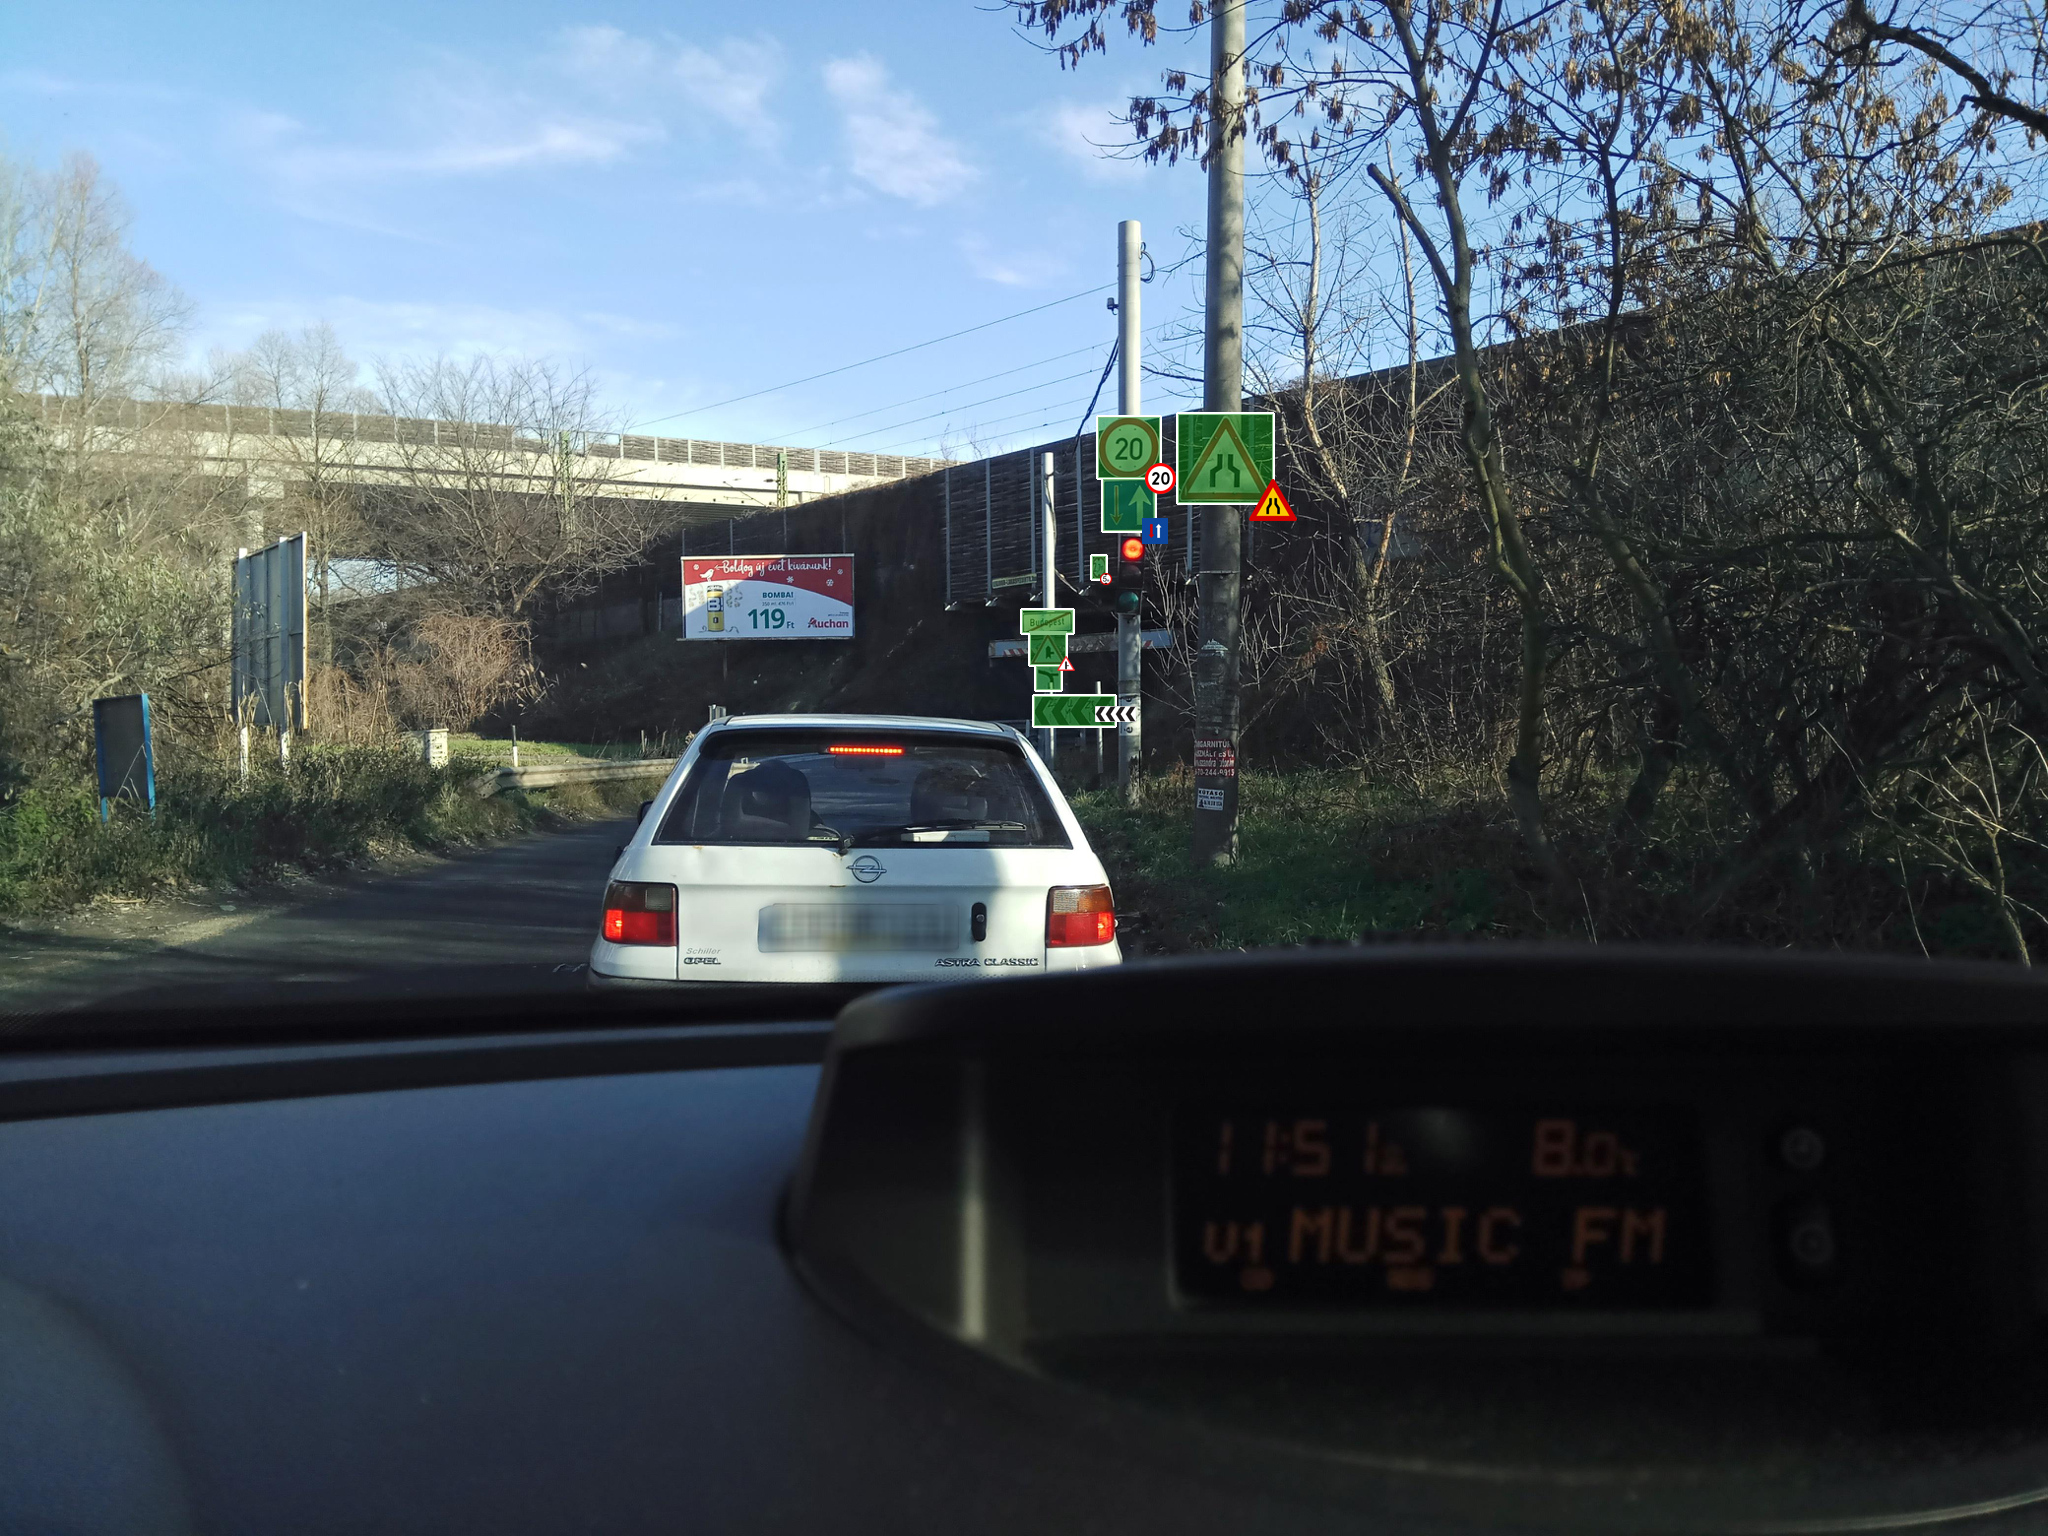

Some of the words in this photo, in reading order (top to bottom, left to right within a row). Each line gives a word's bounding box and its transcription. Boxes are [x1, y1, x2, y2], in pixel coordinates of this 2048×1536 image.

[1115, 437, 1143, 460] 20
[722, 560, 753, 577] Boldog
[756, 561, 765, 577] új
[768, 560, 785, 572] évet
[747, 608, 785, 629] 119
[786, 621, 795, 629] Ft
[807, 617, 849, 629] Auchan
[1029, 617, 1065, 628] Budapest
[685, 947, 722, 955] Schiller
[683, 956, 722, 965] OPEL
[934, 957, 981, 967] ASTRA
[983, 957, 1039, 967] CLASSIC
[1288, 1206, 1524, 1264] MUSIC
[1570, 1206, 1668, 1264] FM
